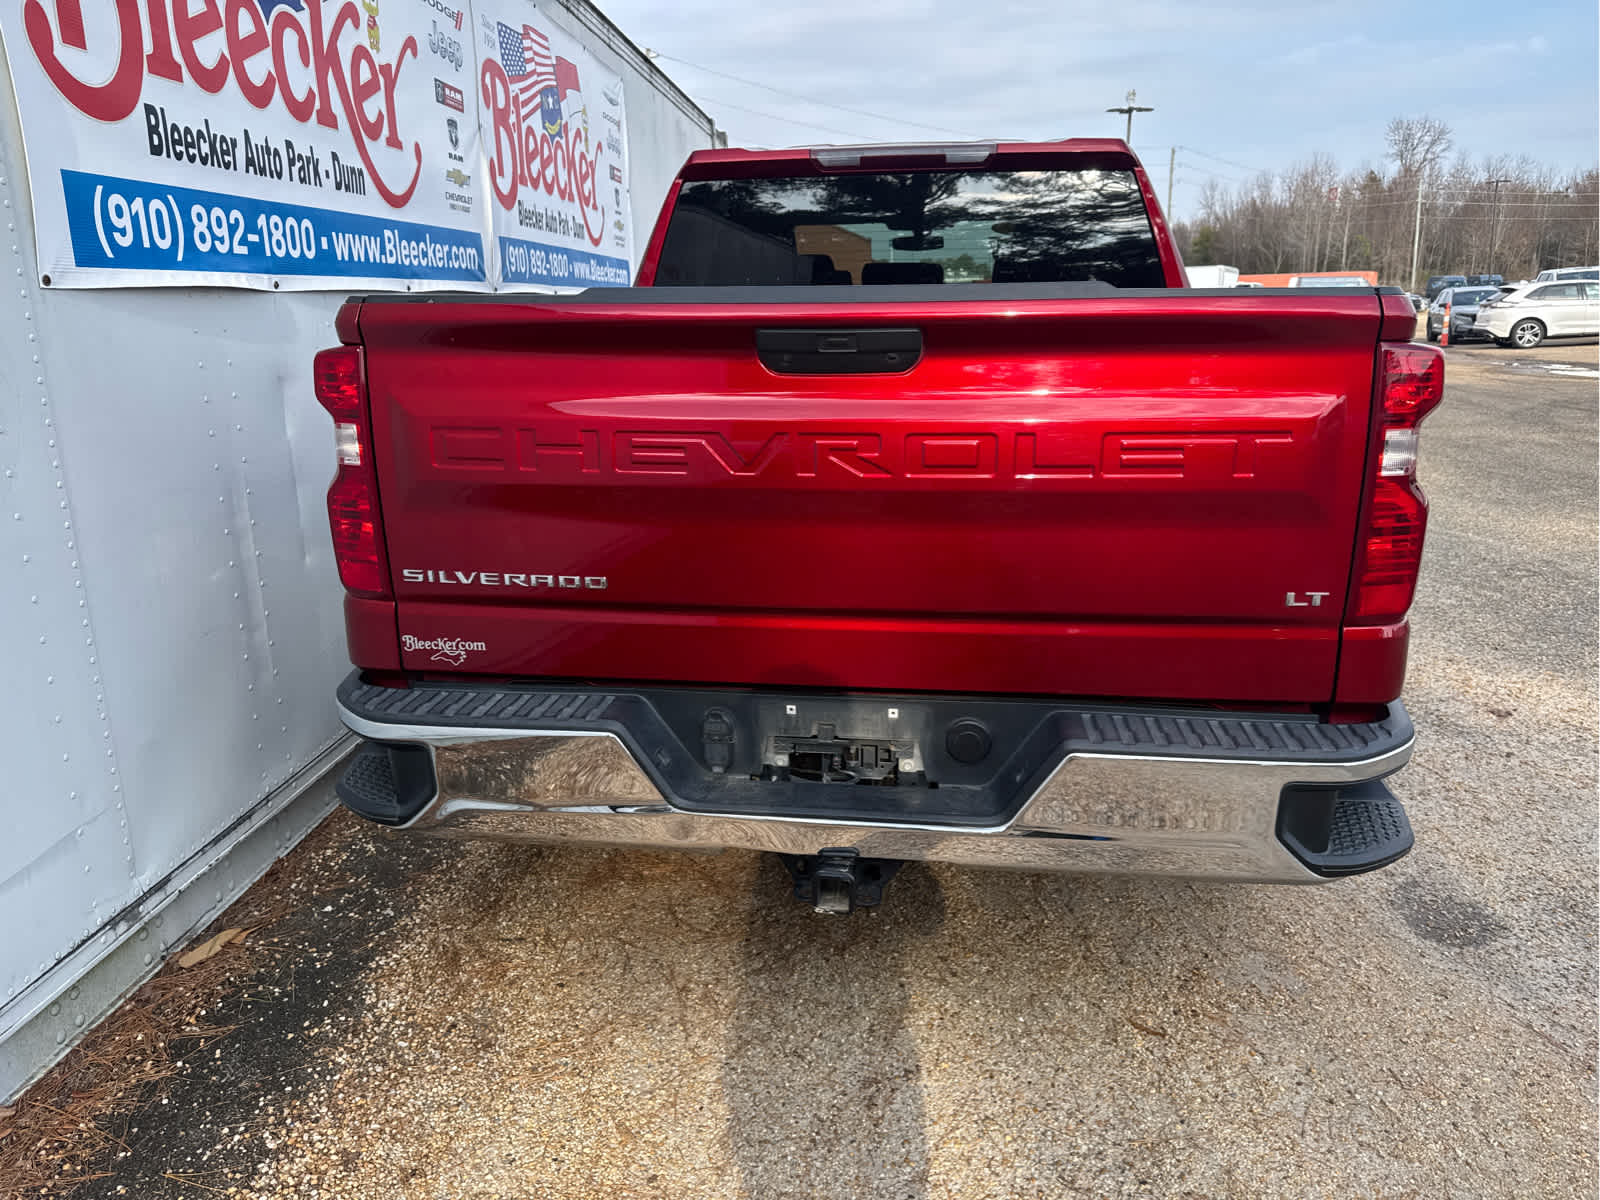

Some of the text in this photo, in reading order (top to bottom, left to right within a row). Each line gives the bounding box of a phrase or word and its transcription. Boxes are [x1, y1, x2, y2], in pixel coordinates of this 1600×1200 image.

[424, 0, 460, 21] ODGE
[428, 19, 463, 72] Jeep
[144, 102, 366, 197] Bleecker Auto Park Dunn
[480, 57, 605, 248] Bleecker
[445, 191, 473, 205] CHEVROLET
[94, 184, 479, 270] (910) 892-1800 www.Bleecker.com
[518, 200, 585, 239] Bleecker Auto Park Dunn
[505, 241, 628, 284] (910) 892-1800 www.Bleecker.com
[430, 426, 1295, 479] CHEVROLET
[402, 568, 608, 589] SILVERADO
[1285, 591, 1331, 607] LT
[401, 634, 486, 652] Bleecker.com
